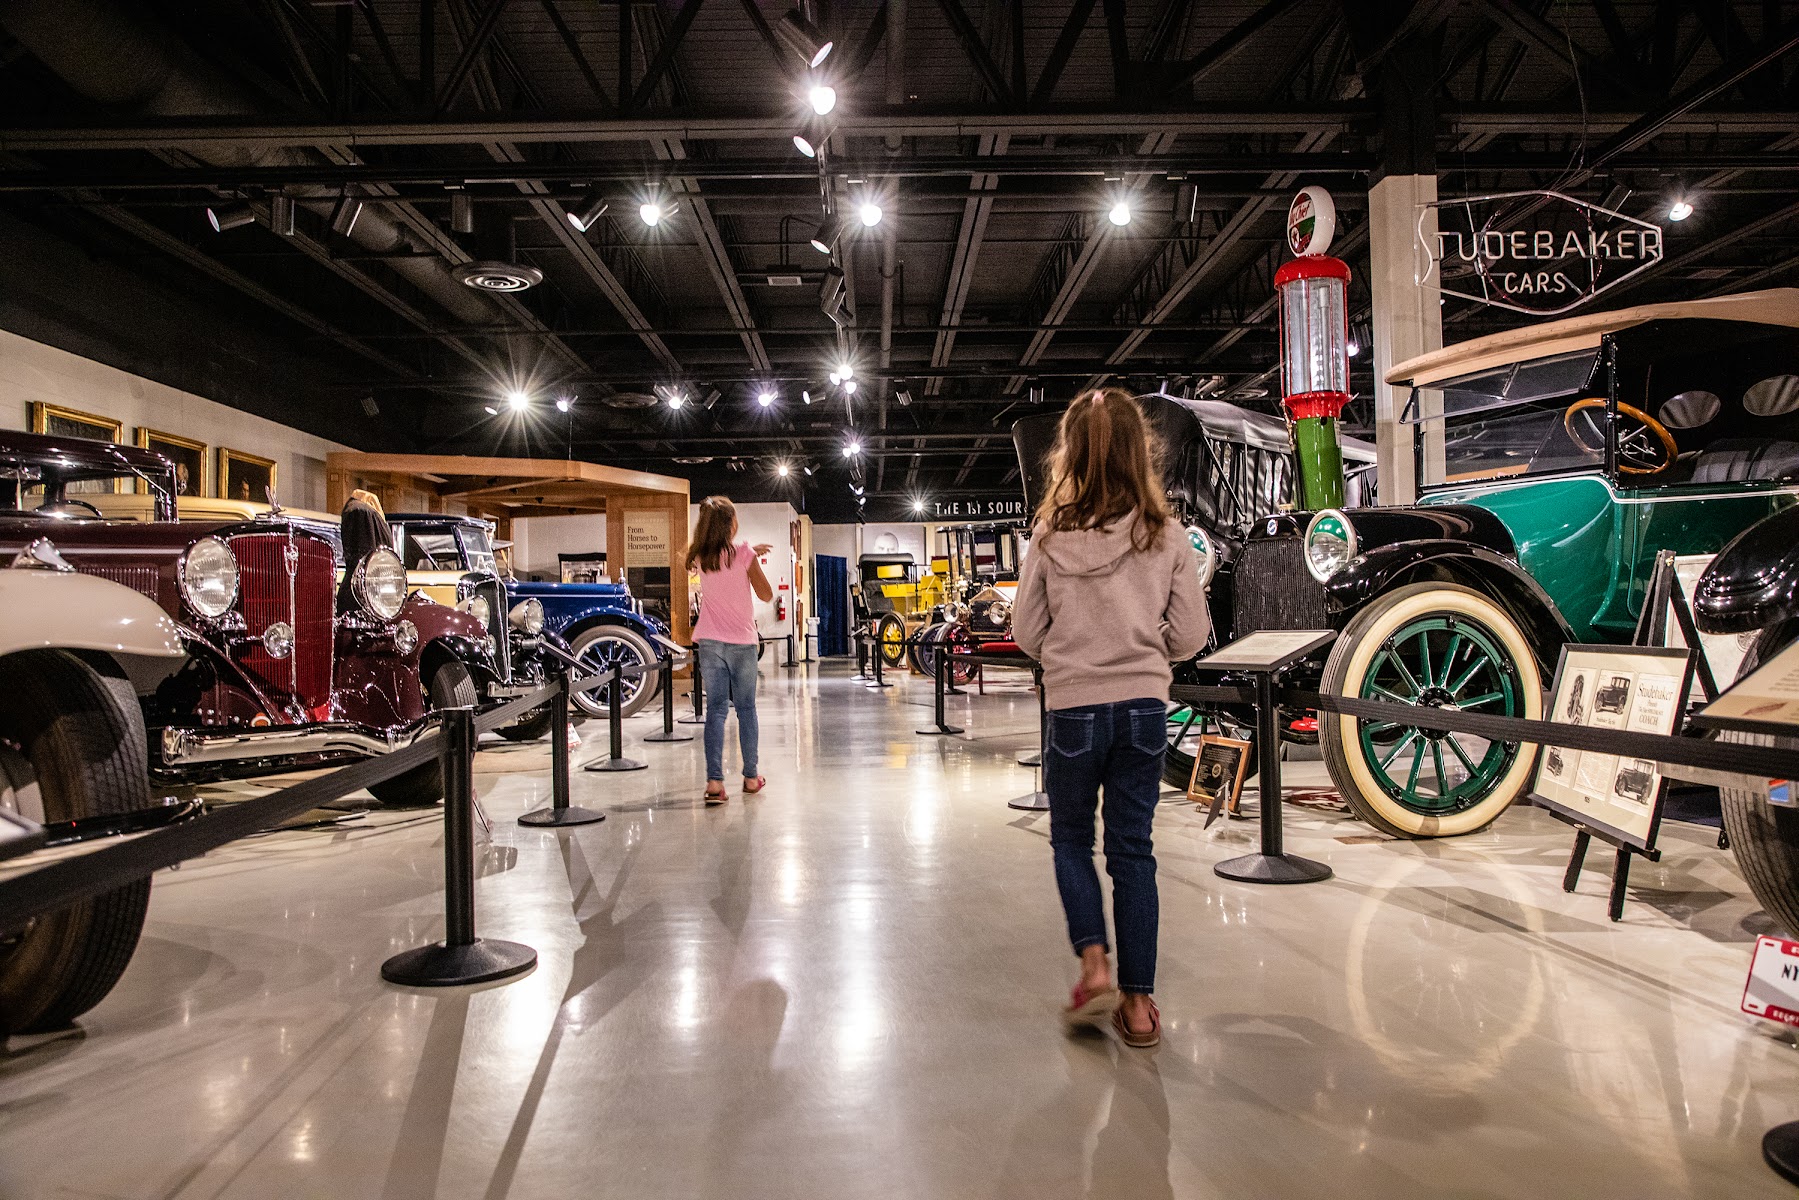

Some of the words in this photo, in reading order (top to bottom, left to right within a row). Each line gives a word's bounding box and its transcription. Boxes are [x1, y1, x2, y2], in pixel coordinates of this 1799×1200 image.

[1505, 272, 1567, 294] CARS
[988, 501, 1027, 515] SOUR
[627, 526, 644, 534] From
[627, 534, 649, 542] Horses
[651, 534, 658, 542] to
[627, 542, 666, 551] Horsepower
